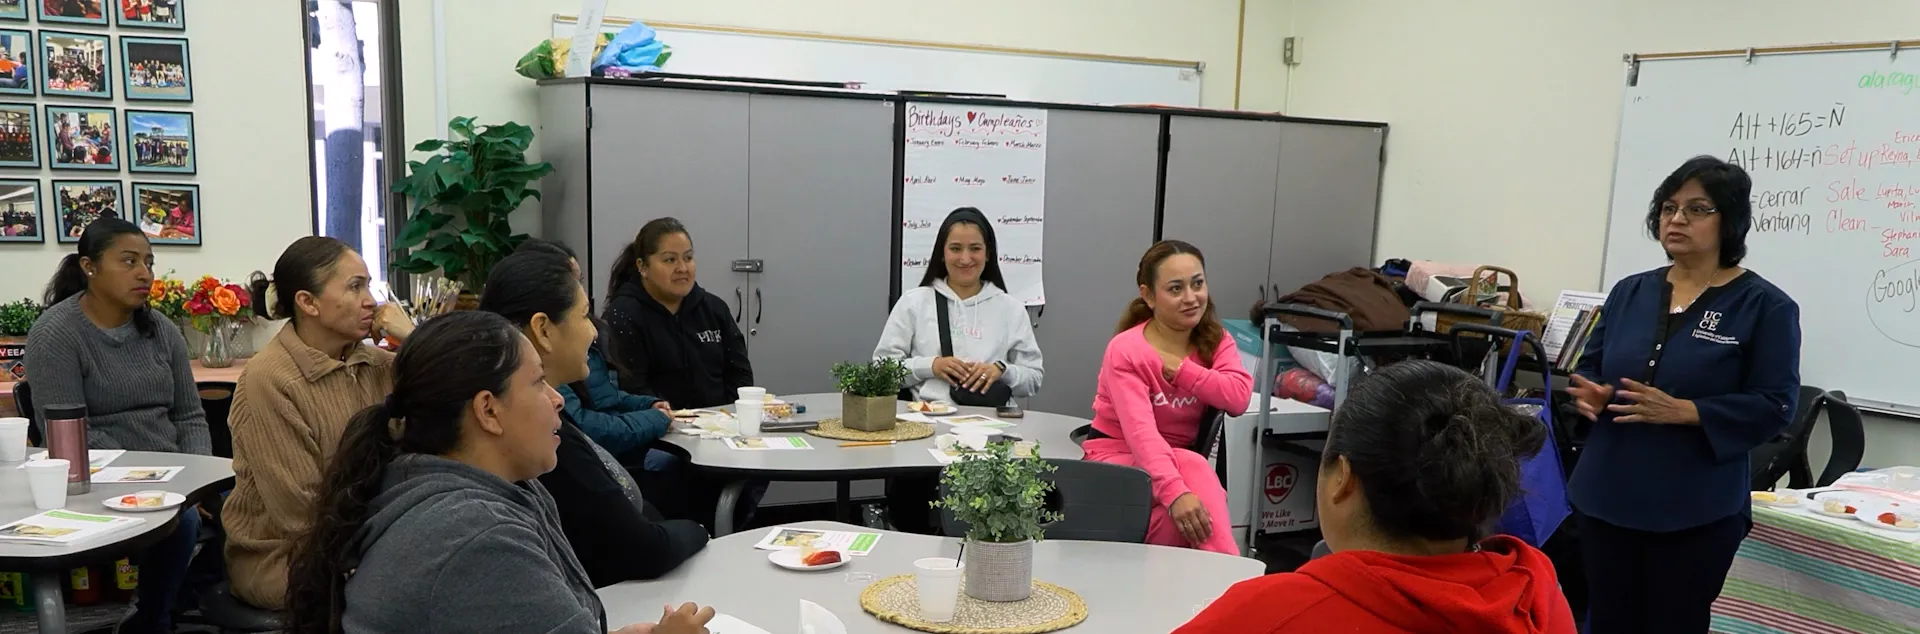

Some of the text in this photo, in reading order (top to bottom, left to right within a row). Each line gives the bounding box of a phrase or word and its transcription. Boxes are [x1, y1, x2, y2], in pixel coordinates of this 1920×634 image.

[908, 105, 1034, 137] Birthdays Cumpleaños
[1729, 111, 1761, 140] Alt
[1727, 146, 1760, 171] Alt
[1823, 140, 1881, 171] Set up
[1826, 178, 1867, 203] Sale
[1826, 208, 1867, 233] Clean
[1883, 242, 1909, 258] Sara
[1703, 310, 1723, 322] UC
[1699, 319, 1720, 331] CE
[696, 329, 722, 343] PINK
[1265, 474, 1293, 490] LBC
[1262, 509, 1292, 519] We Like
[1266, 519, 1287, 529] Move
[1288, 518, 1295, 527] It
